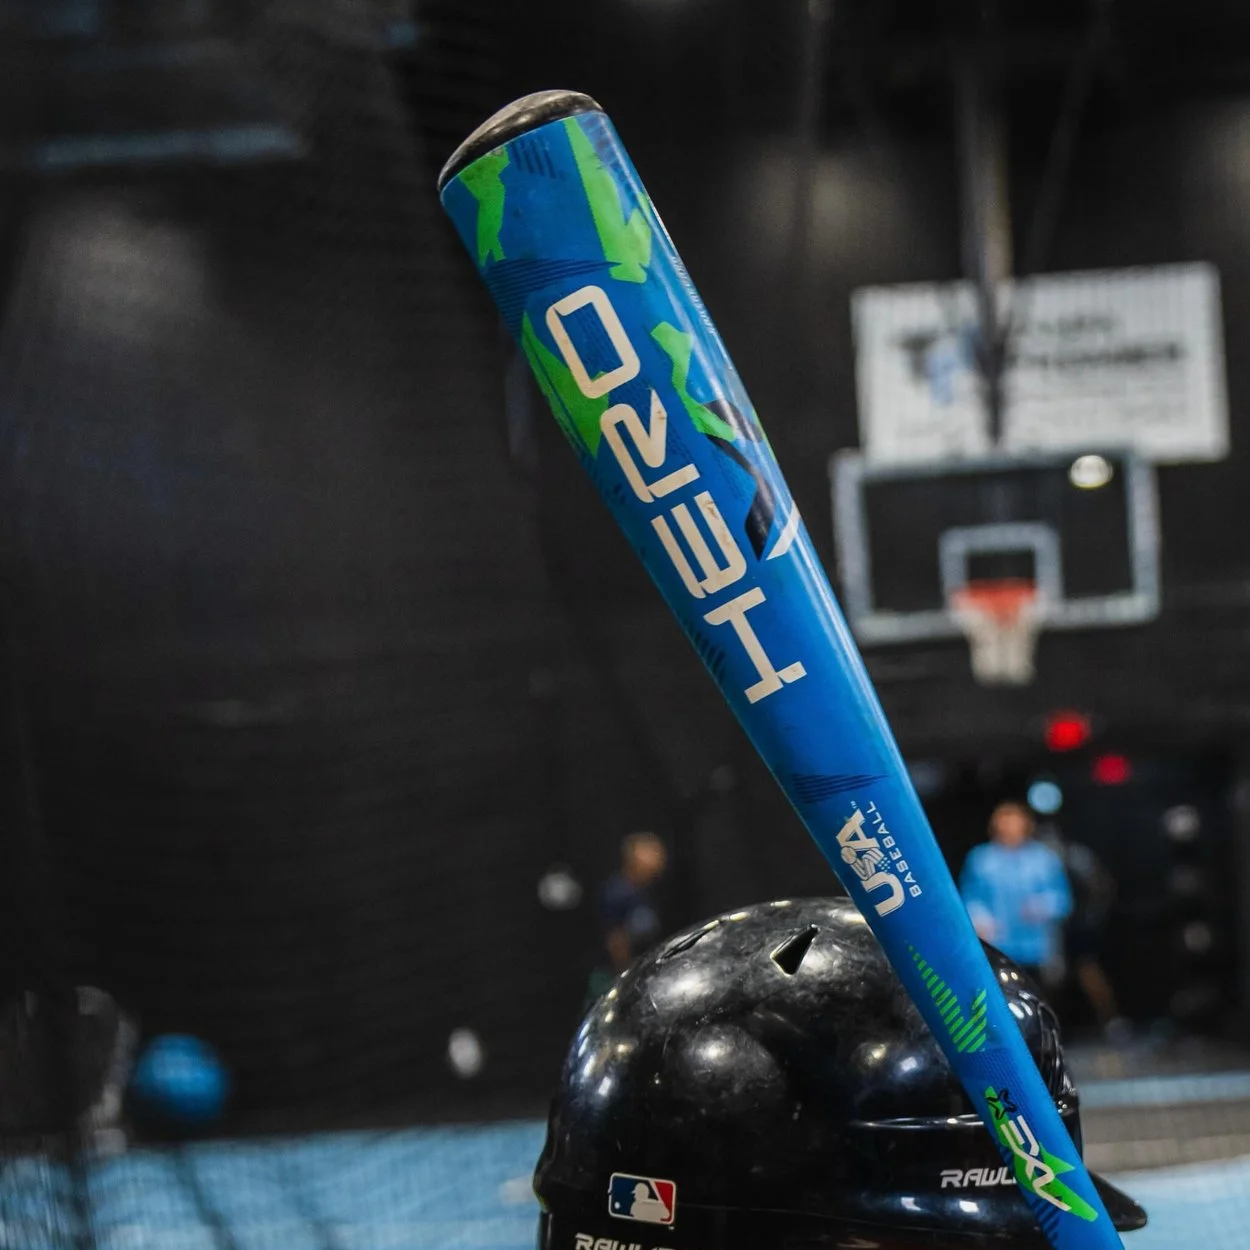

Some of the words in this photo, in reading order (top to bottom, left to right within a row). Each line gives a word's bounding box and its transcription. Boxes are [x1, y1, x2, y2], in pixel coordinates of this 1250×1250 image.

[546, 285, 807, 704] HERO
[836, 809, 906, 917] USA
[866, 801, 922, 897] BASEBALL
[940, 1167, 1017, 1188] RAWL
